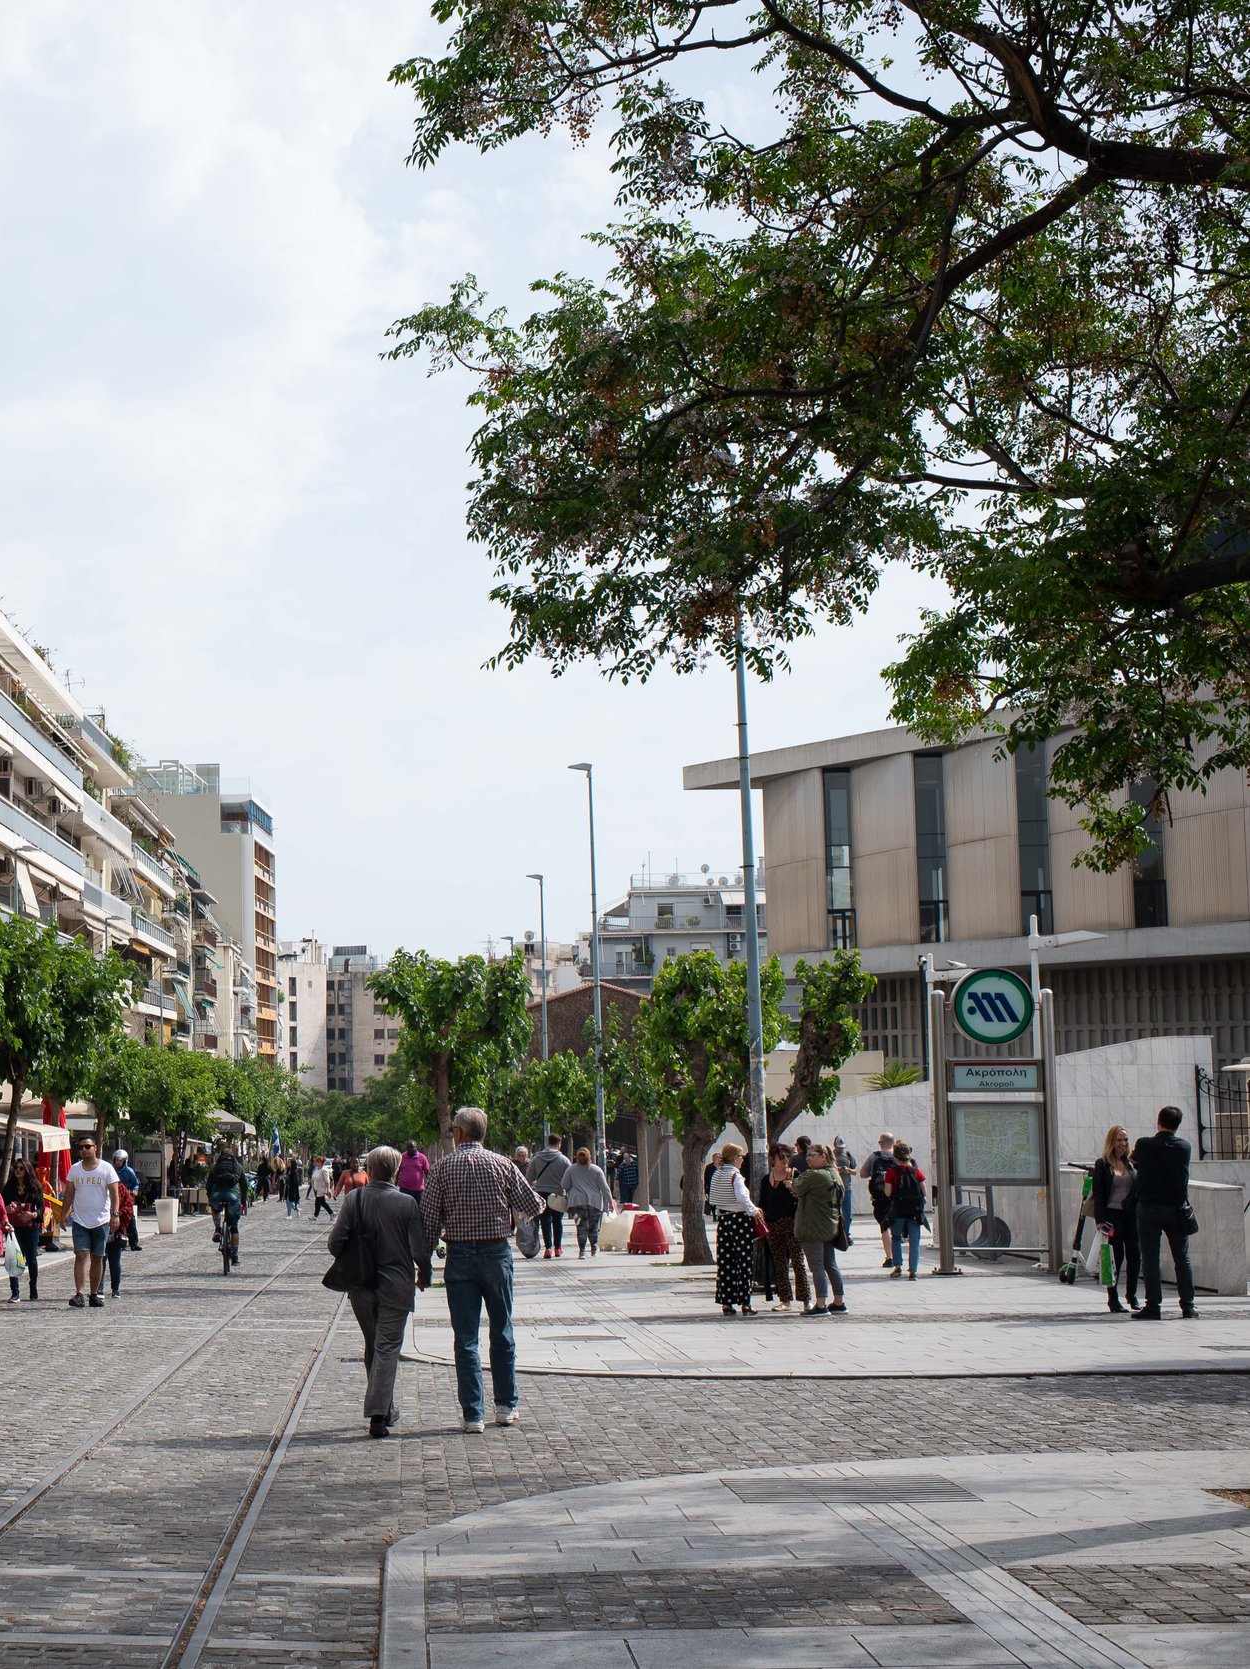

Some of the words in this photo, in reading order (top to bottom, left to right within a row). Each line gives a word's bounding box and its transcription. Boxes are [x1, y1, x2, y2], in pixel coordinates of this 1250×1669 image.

[966, 1068, 1027, 1078] Ακρόπολη
[979, 1080, 1014, 1088] Akropoli
[138, 1159, 158, 1169] Yard
[75, 1176, 102, 1185] HYPED
